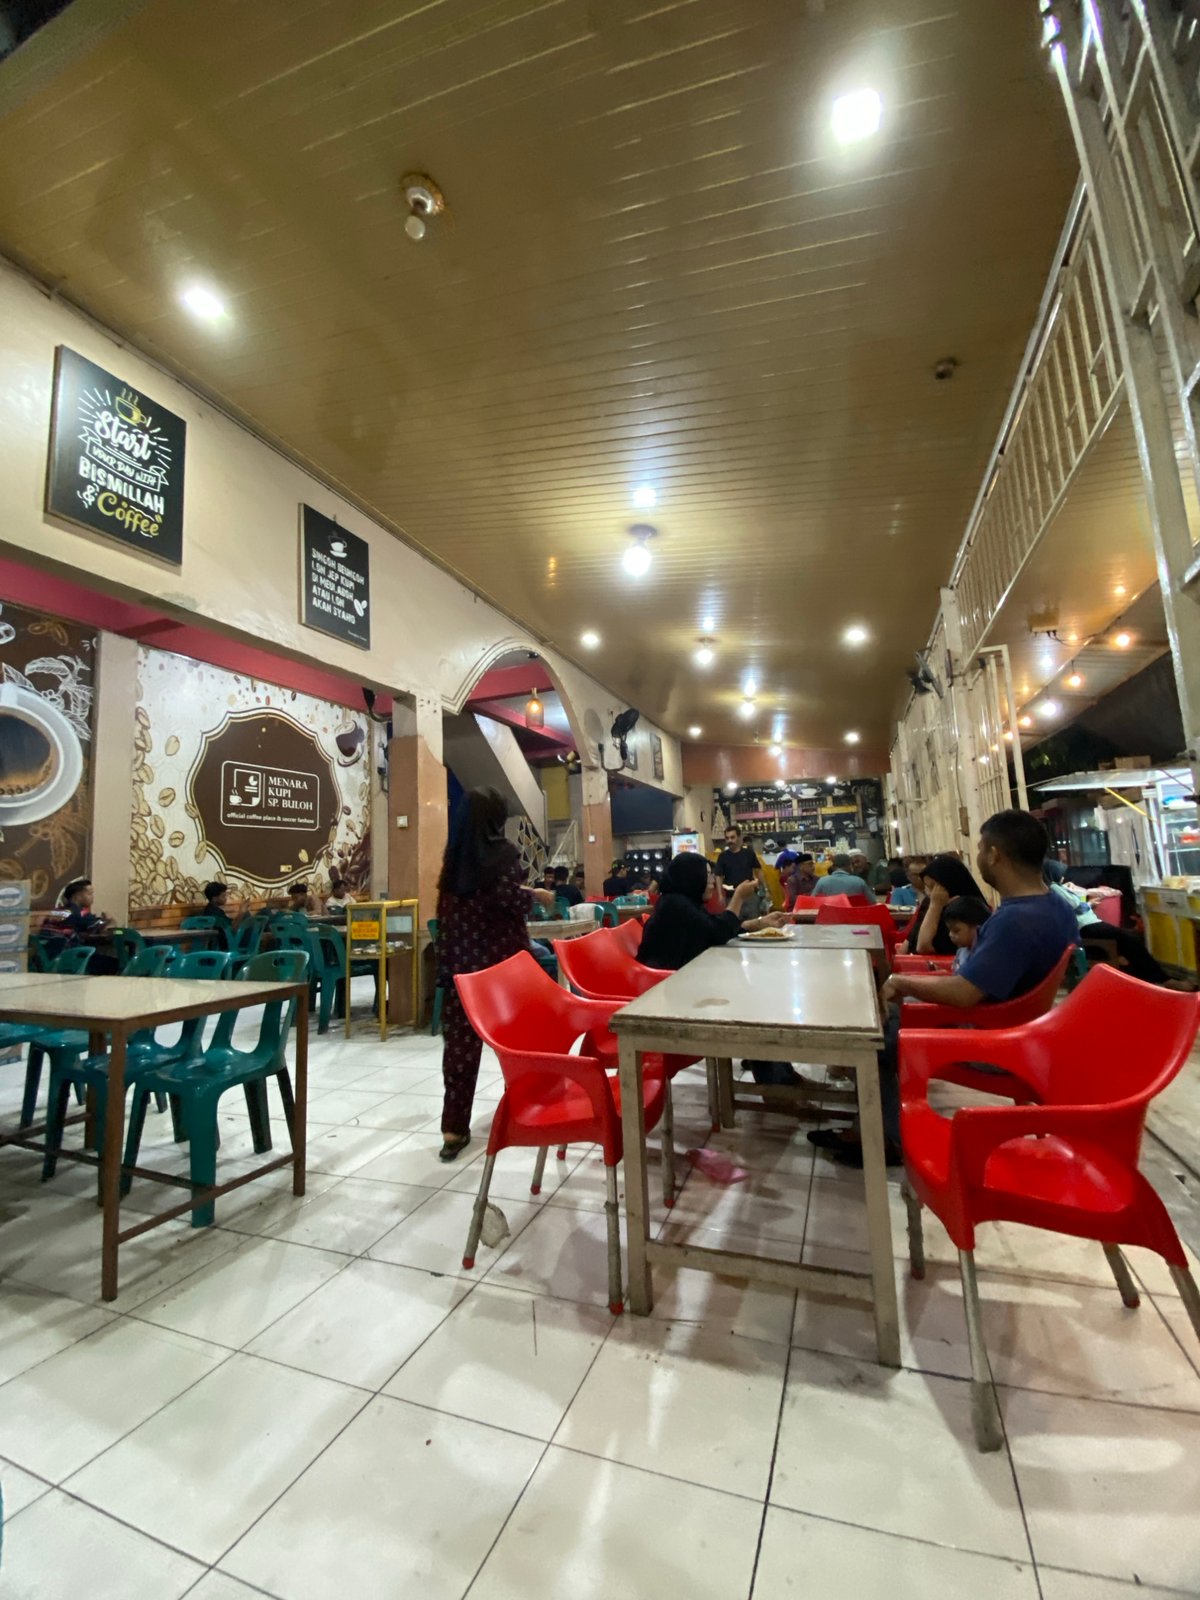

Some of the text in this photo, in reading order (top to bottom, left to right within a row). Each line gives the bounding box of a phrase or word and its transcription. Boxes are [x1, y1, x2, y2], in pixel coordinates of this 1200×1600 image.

[95, 411, 156, 460] Start
[79, 456, 164, 515] BISMILLAH
[97, 491, 159, 535] Coffee
[327, 569, 339, 581] JEP
[312, 585, 331, 600] ATAU
[312, 597, 332, 613] AKAN
[268, 776, 308, 790] MENARA
[268, 787, 291, 798] KUPI
[268, 798, 313, 810] SP. BULOH
